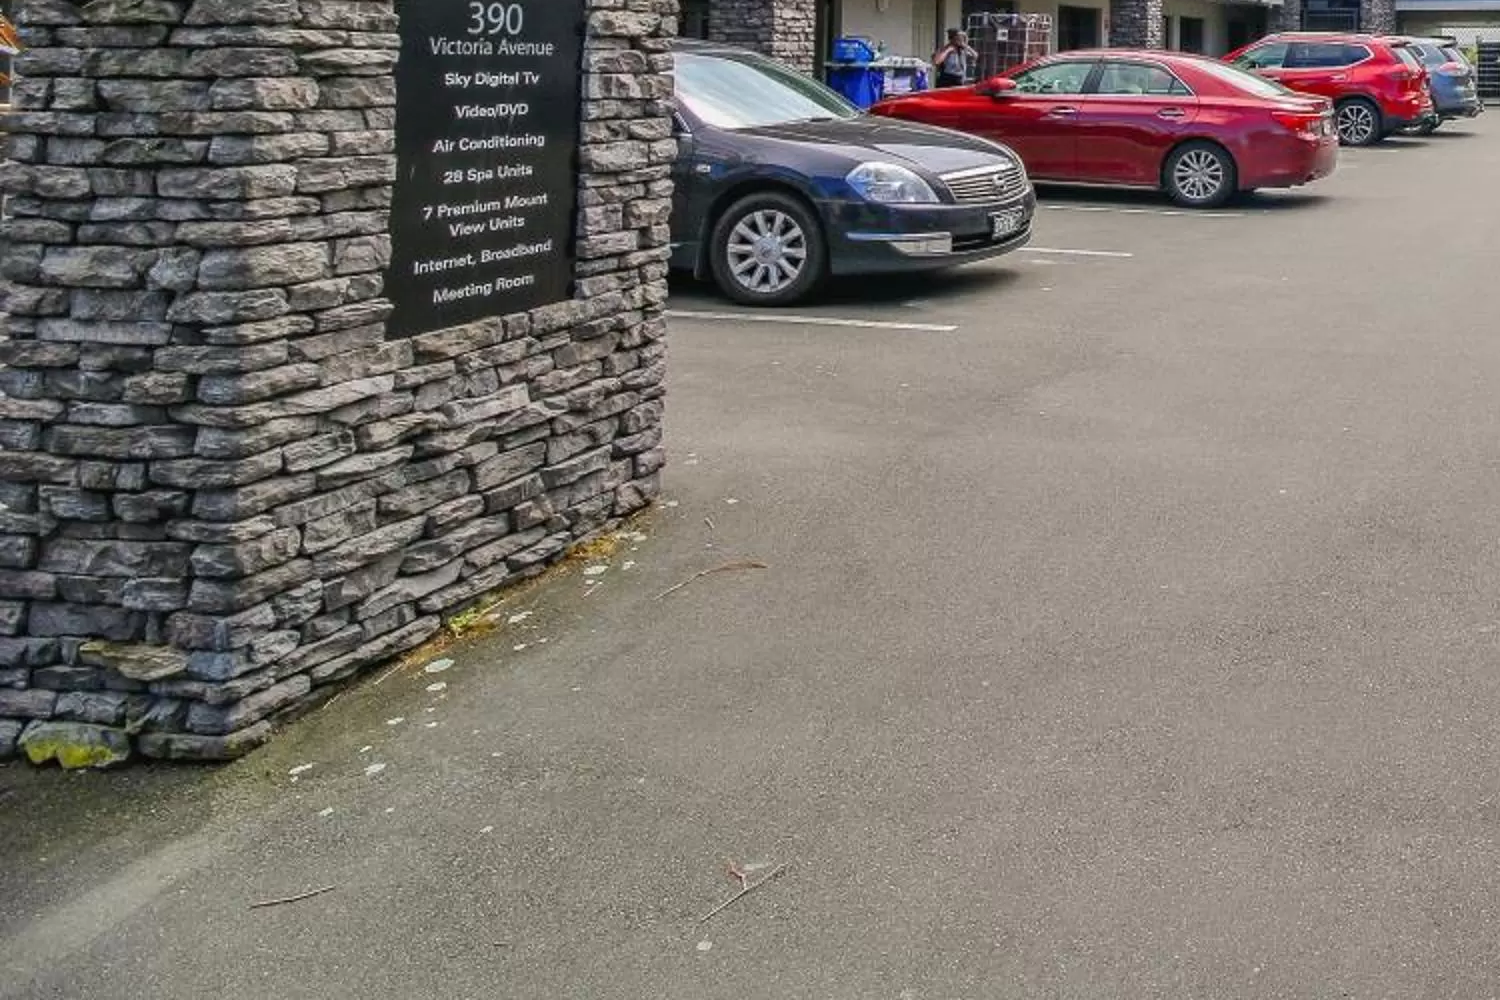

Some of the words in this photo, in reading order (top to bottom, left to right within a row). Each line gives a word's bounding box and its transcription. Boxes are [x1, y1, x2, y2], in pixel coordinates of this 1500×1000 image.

[467, 2, 524, 35] 390
[429, 36, 493, 57] Victoria
[498, 38, 554, 56] Avenue
[444, 72, 471, 87] Sky
[475, 71, 519, 87] Digital
[455, 103, 529, 119] Video/DVD
[432, 138, 454, 153] Air
[459, 133, 545, 151] Conditioning
[443, 170, 463, 184] 28
[467, 168, 493, 184] Spa
[498, 163, 533, 178] Units
[423, 206, 433, 220] 7
[437, 199, 500, 219] Premium
[505, 192, 548, 209] Mount
[449, 221, 485, 238] View
[489, 215, 525, 232] Units
[481, 239, 552, 263] Broadband
[433, 281, 493, 303] Meeting
[496, 273, 535, 291] Room
